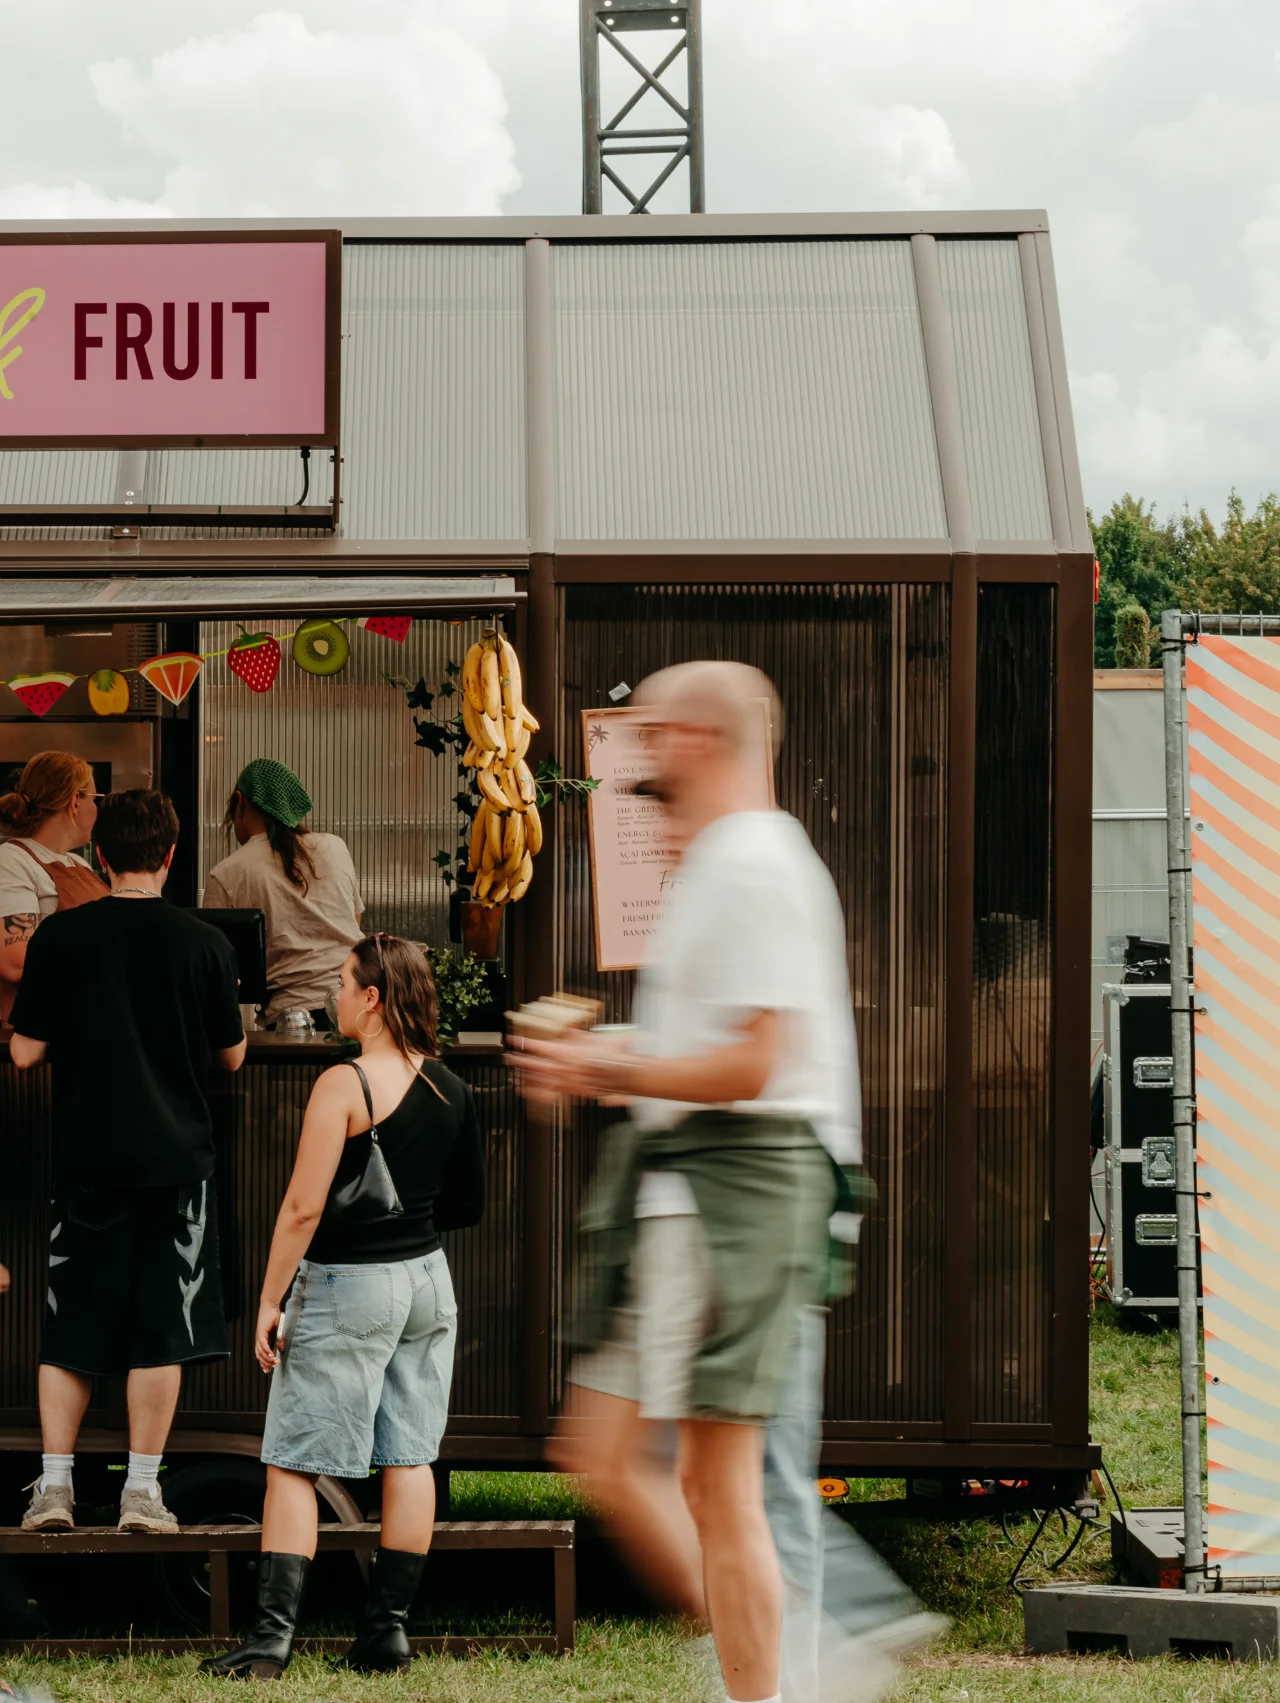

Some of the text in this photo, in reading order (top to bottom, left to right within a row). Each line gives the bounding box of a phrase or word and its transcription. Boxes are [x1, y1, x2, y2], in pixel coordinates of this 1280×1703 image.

[74, 301, 270, 380] FRUIT
[613, 767, 634, 775] LOVE
[617, 831, 649, 839] ENERGY
[622, 914, 649, 923] FRESH
